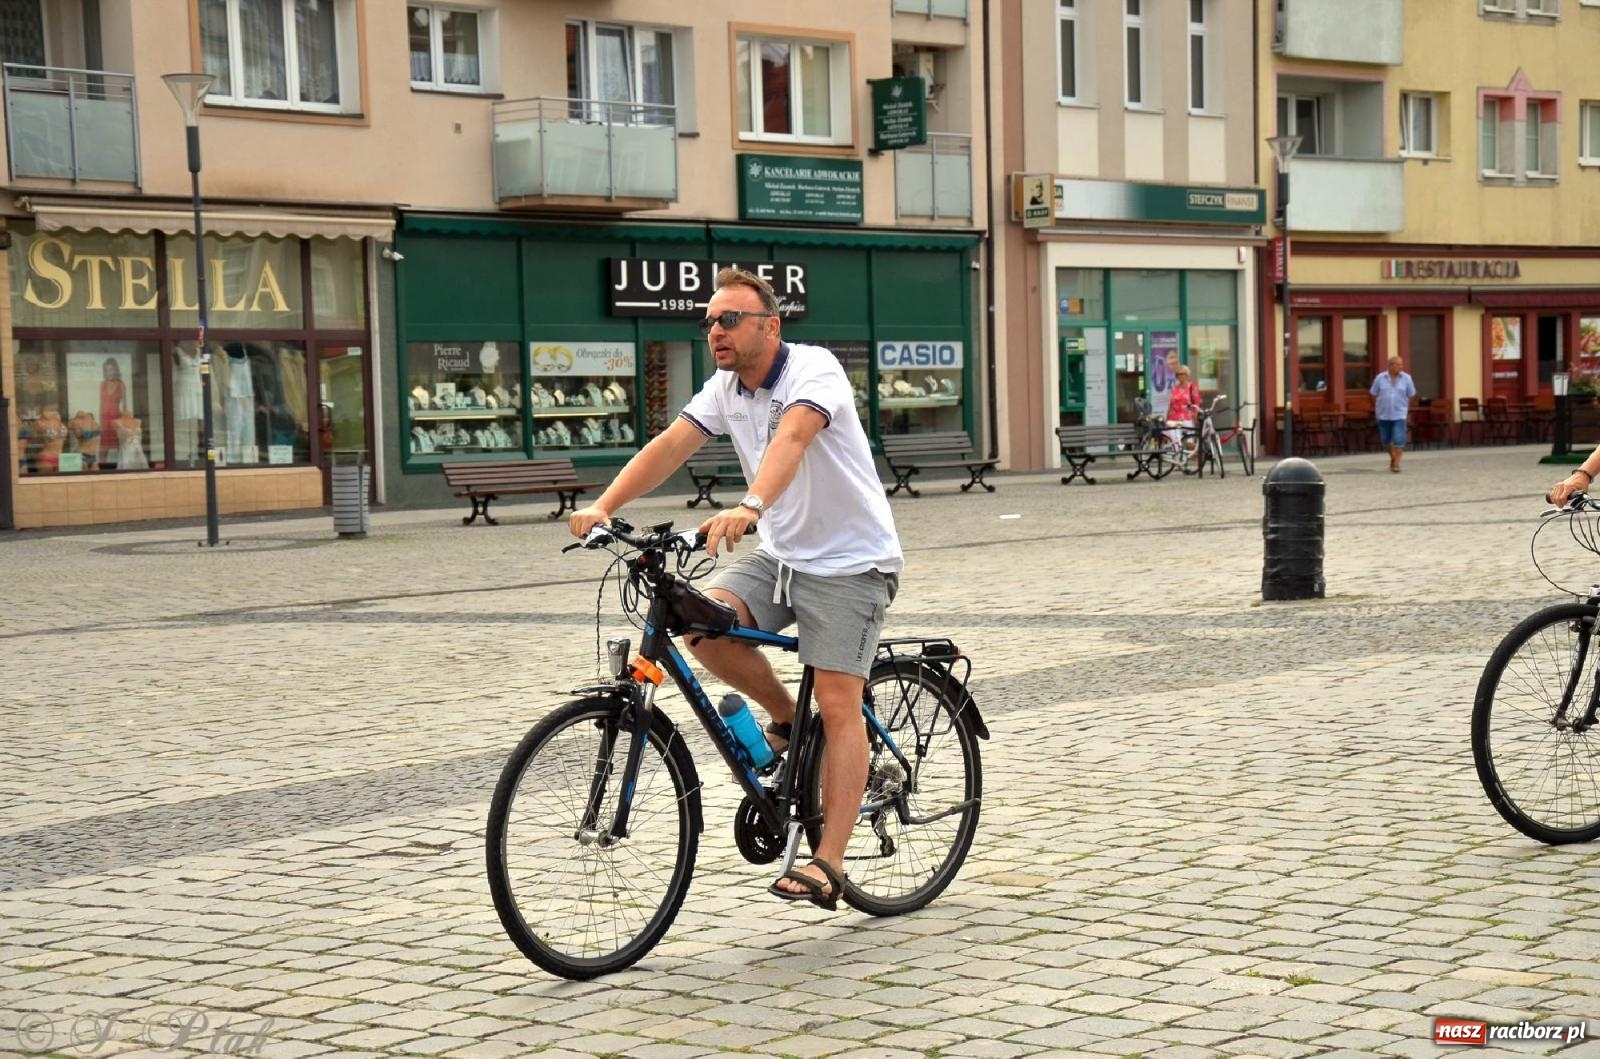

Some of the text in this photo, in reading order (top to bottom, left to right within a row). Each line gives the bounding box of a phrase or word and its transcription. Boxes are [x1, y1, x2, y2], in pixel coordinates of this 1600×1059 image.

[764, 166, 812, 178] KANCELARIE
[24, 237, 291, 311] STELLA
[614, 260, 806, 295] JUBIER
[1404, 259, 1521, 279] RESTAURACJA
[661, 299, 694, 311] 1989
[434, 343, 462, 356] Pierre
[879, 343, 956, 366] CASIO
[438, 352, 470, 371] Ricaud
